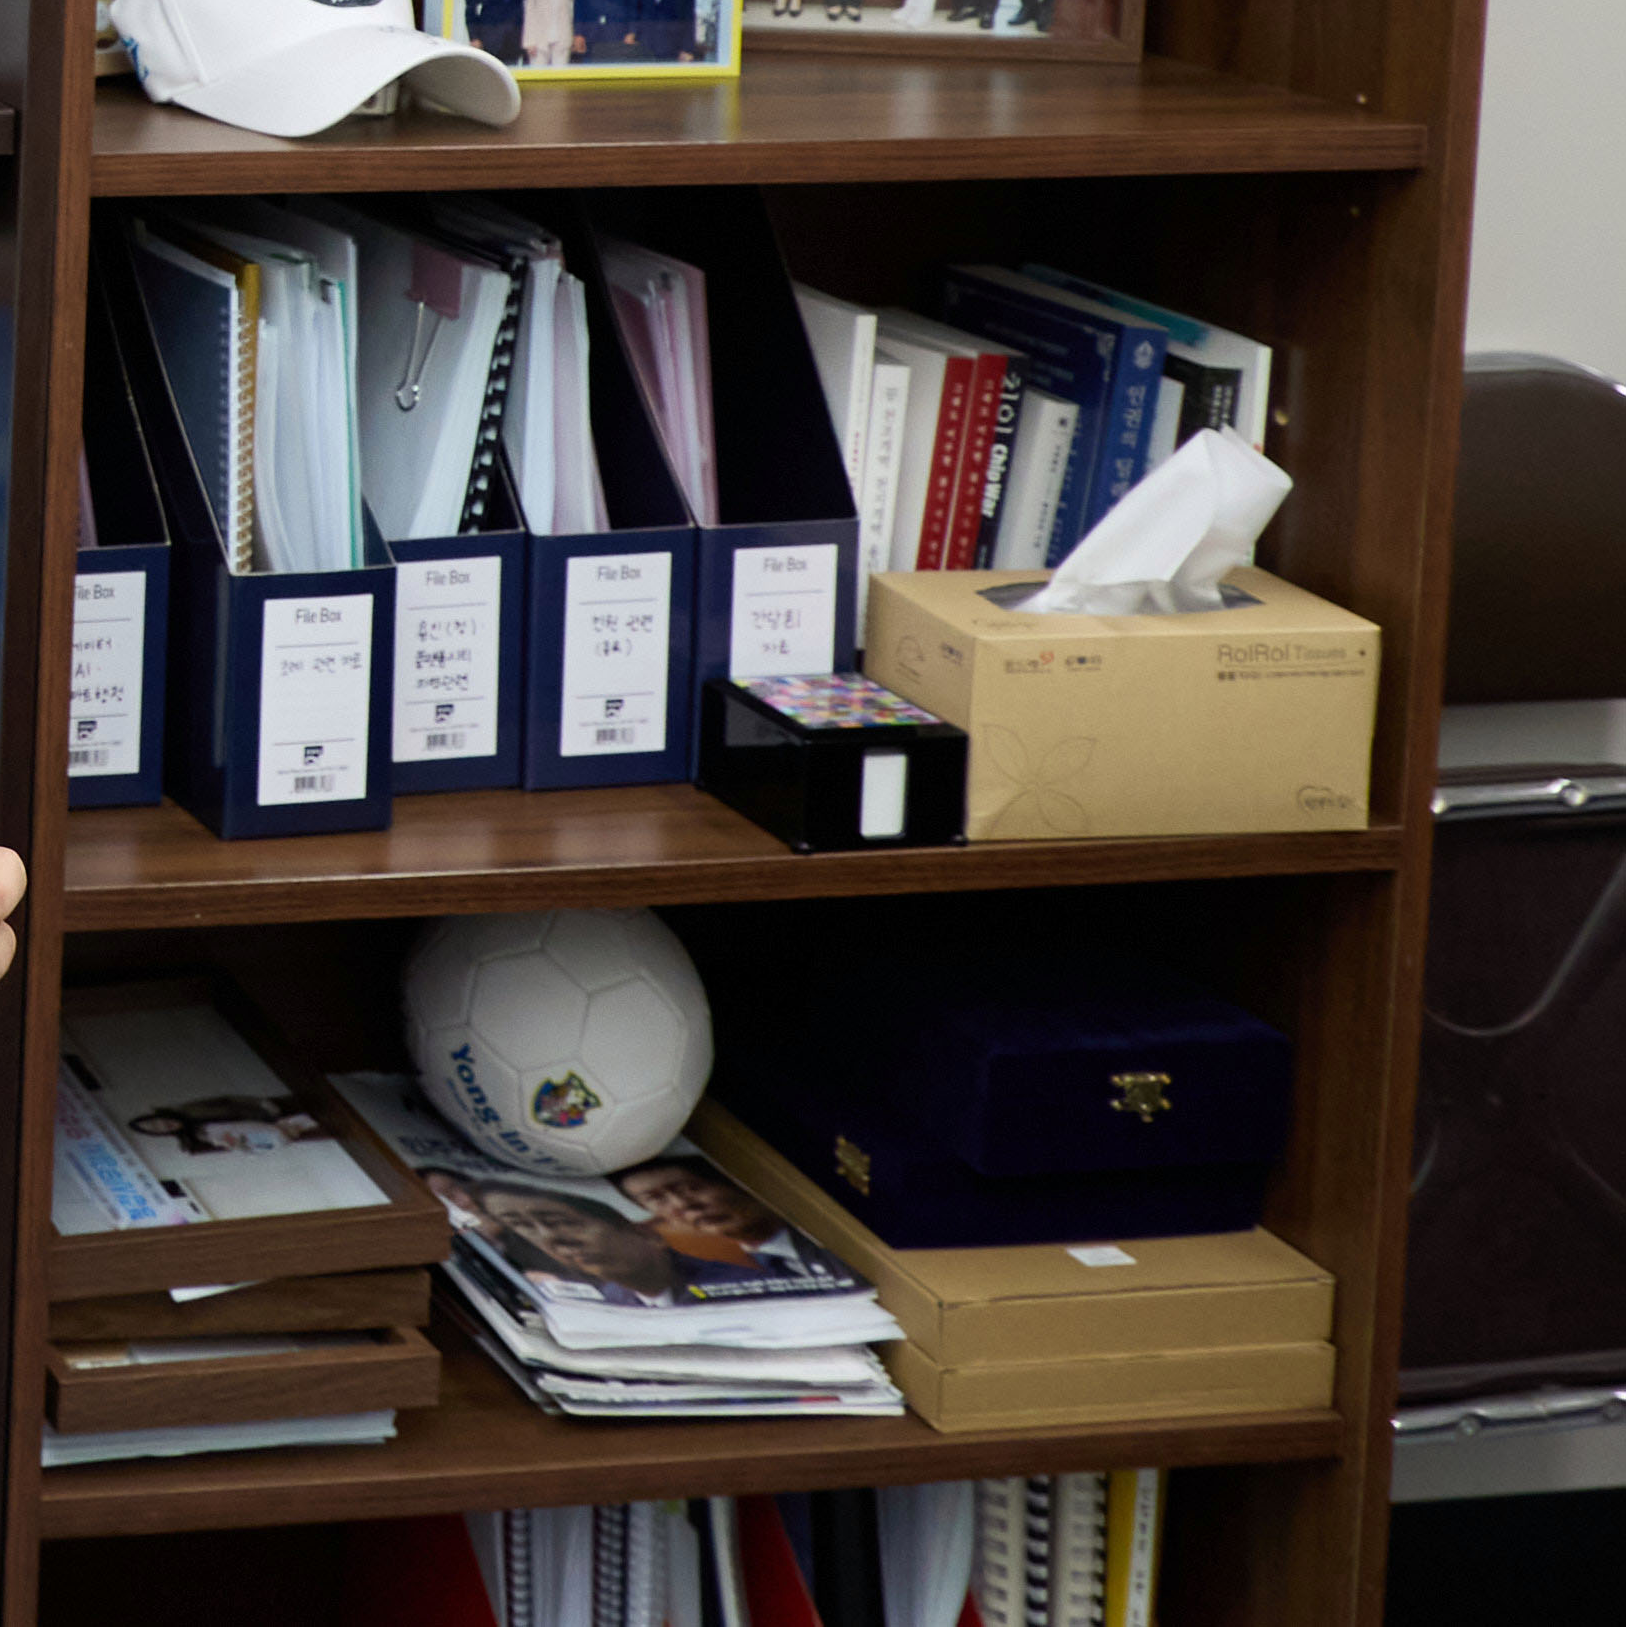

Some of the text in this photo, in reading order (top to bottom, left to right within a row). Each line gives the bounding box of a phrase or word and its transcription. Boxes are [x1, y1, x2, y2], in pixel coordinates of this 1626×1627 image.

[764, 556, 807, 573] File Box
[425, 570, 471, 585] File Box
[597, 565, 642, 581] File Box
[93, 584, 115, 599] Box
[295, 608, 342, 623] File Box
